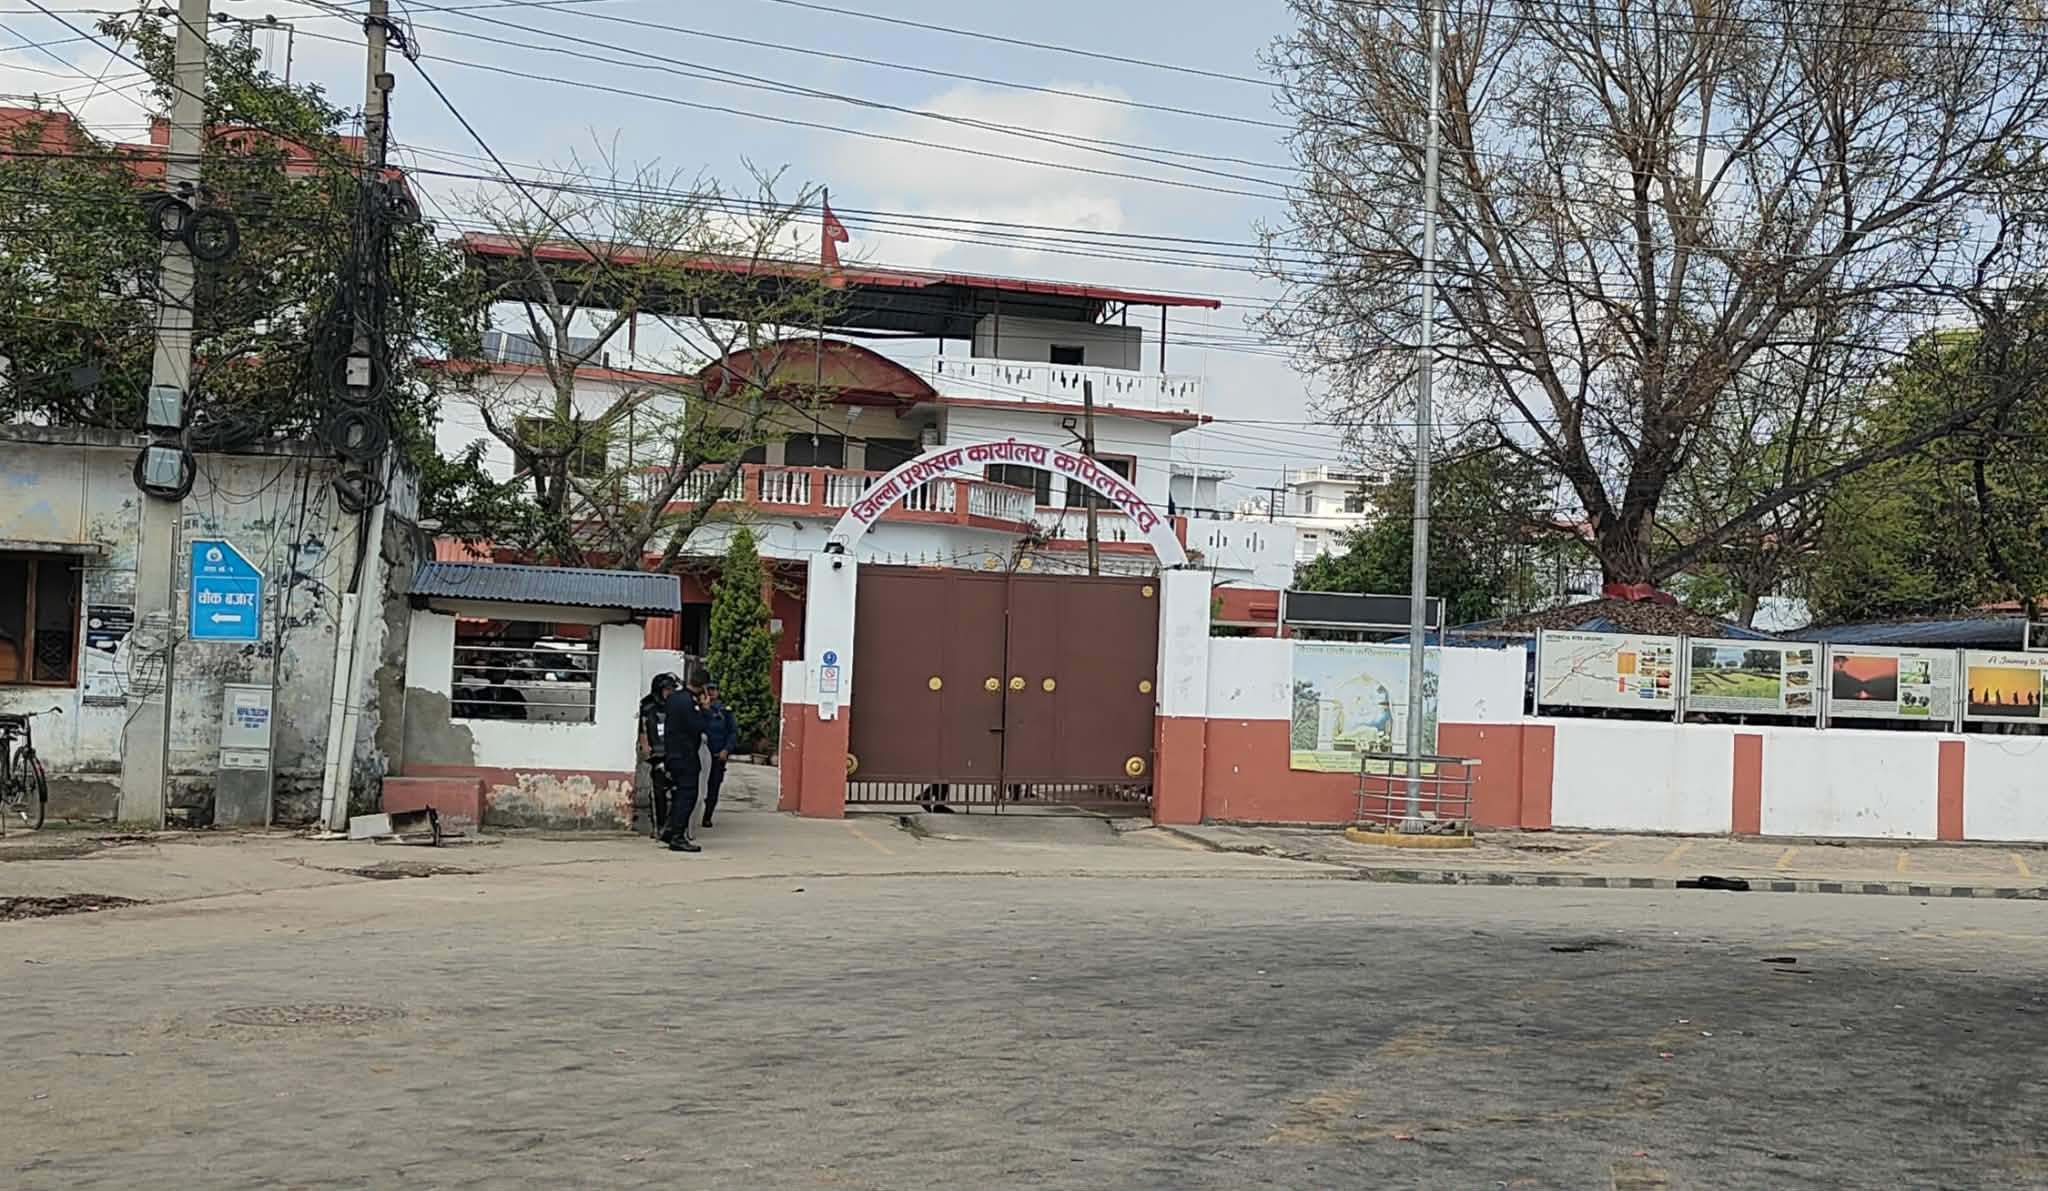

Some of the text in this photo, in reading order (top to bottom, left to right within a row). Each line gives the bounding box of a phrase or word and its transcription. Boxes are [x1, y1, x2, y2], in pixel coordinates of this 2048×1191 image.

[851, 437, 1160, 533] जिल्ला प्रशासन कार्यालय कपिलवस्तु
[1999, 655, 2029, 667] Journey
